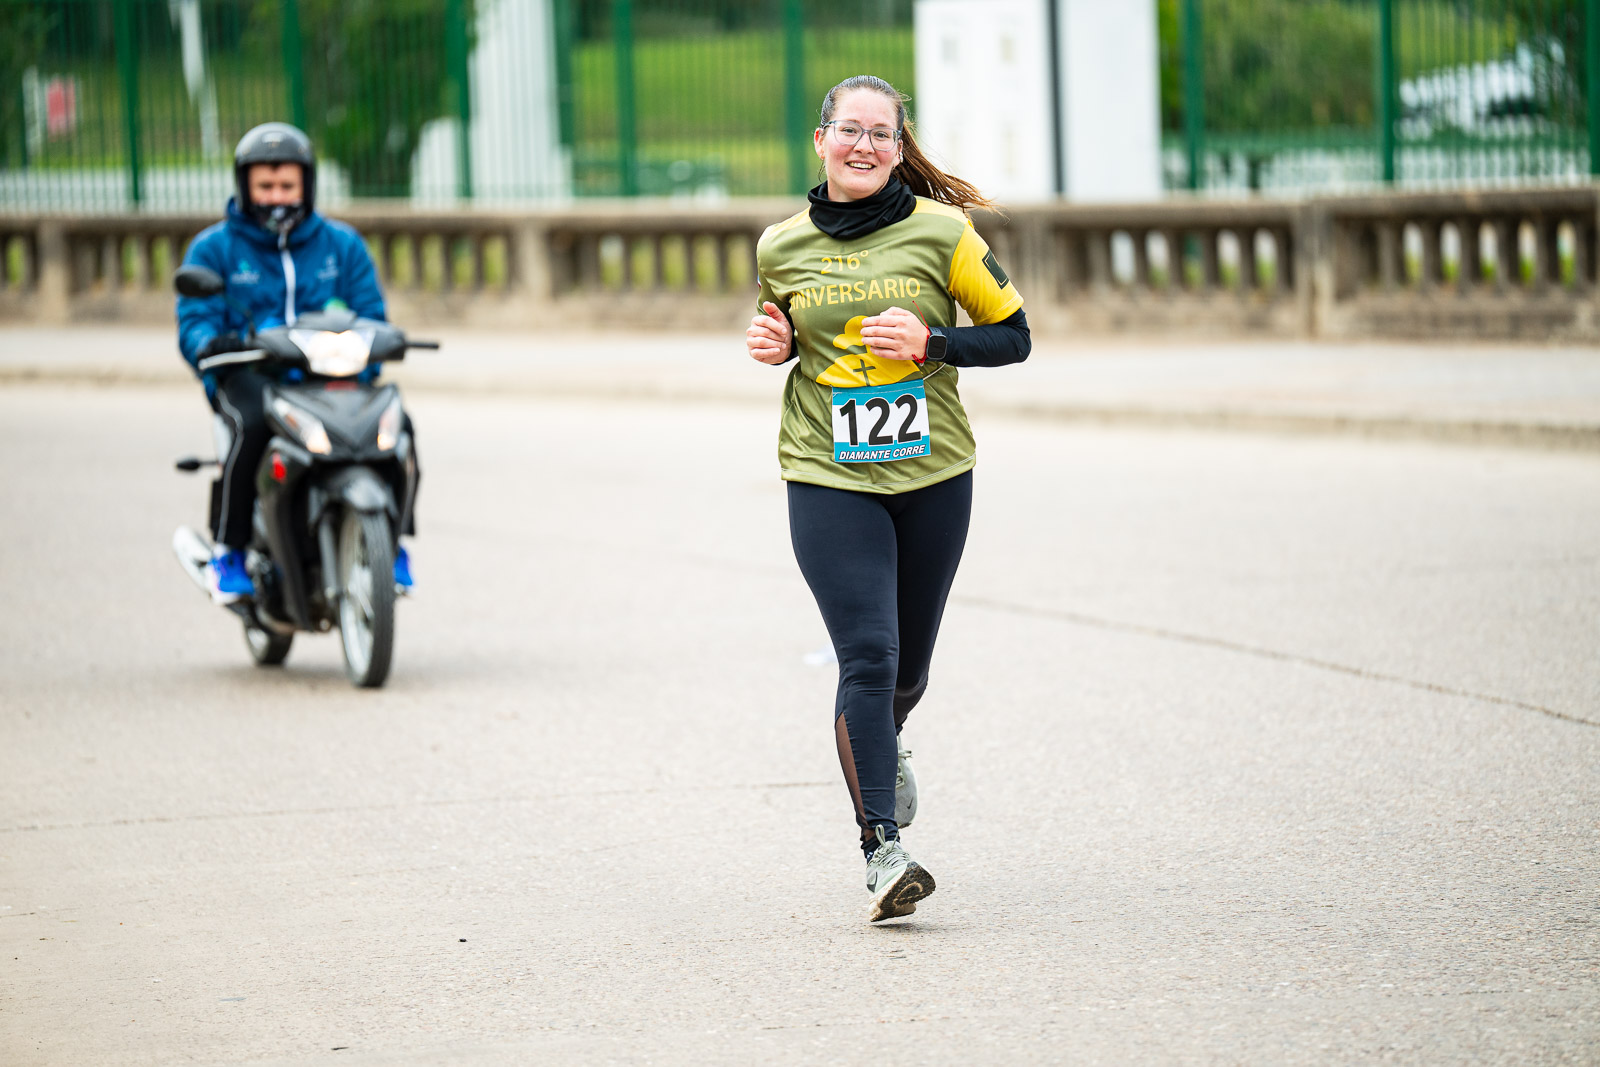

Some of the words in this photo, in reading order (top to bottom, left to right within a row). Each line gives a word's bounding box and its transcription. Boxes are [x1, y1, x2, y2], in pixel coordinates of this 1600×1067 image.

[839, 393, 922, 447] 122
[839, 449, 891, 460] DIAMANTE
[892, 444, 926, 458] CORRE
